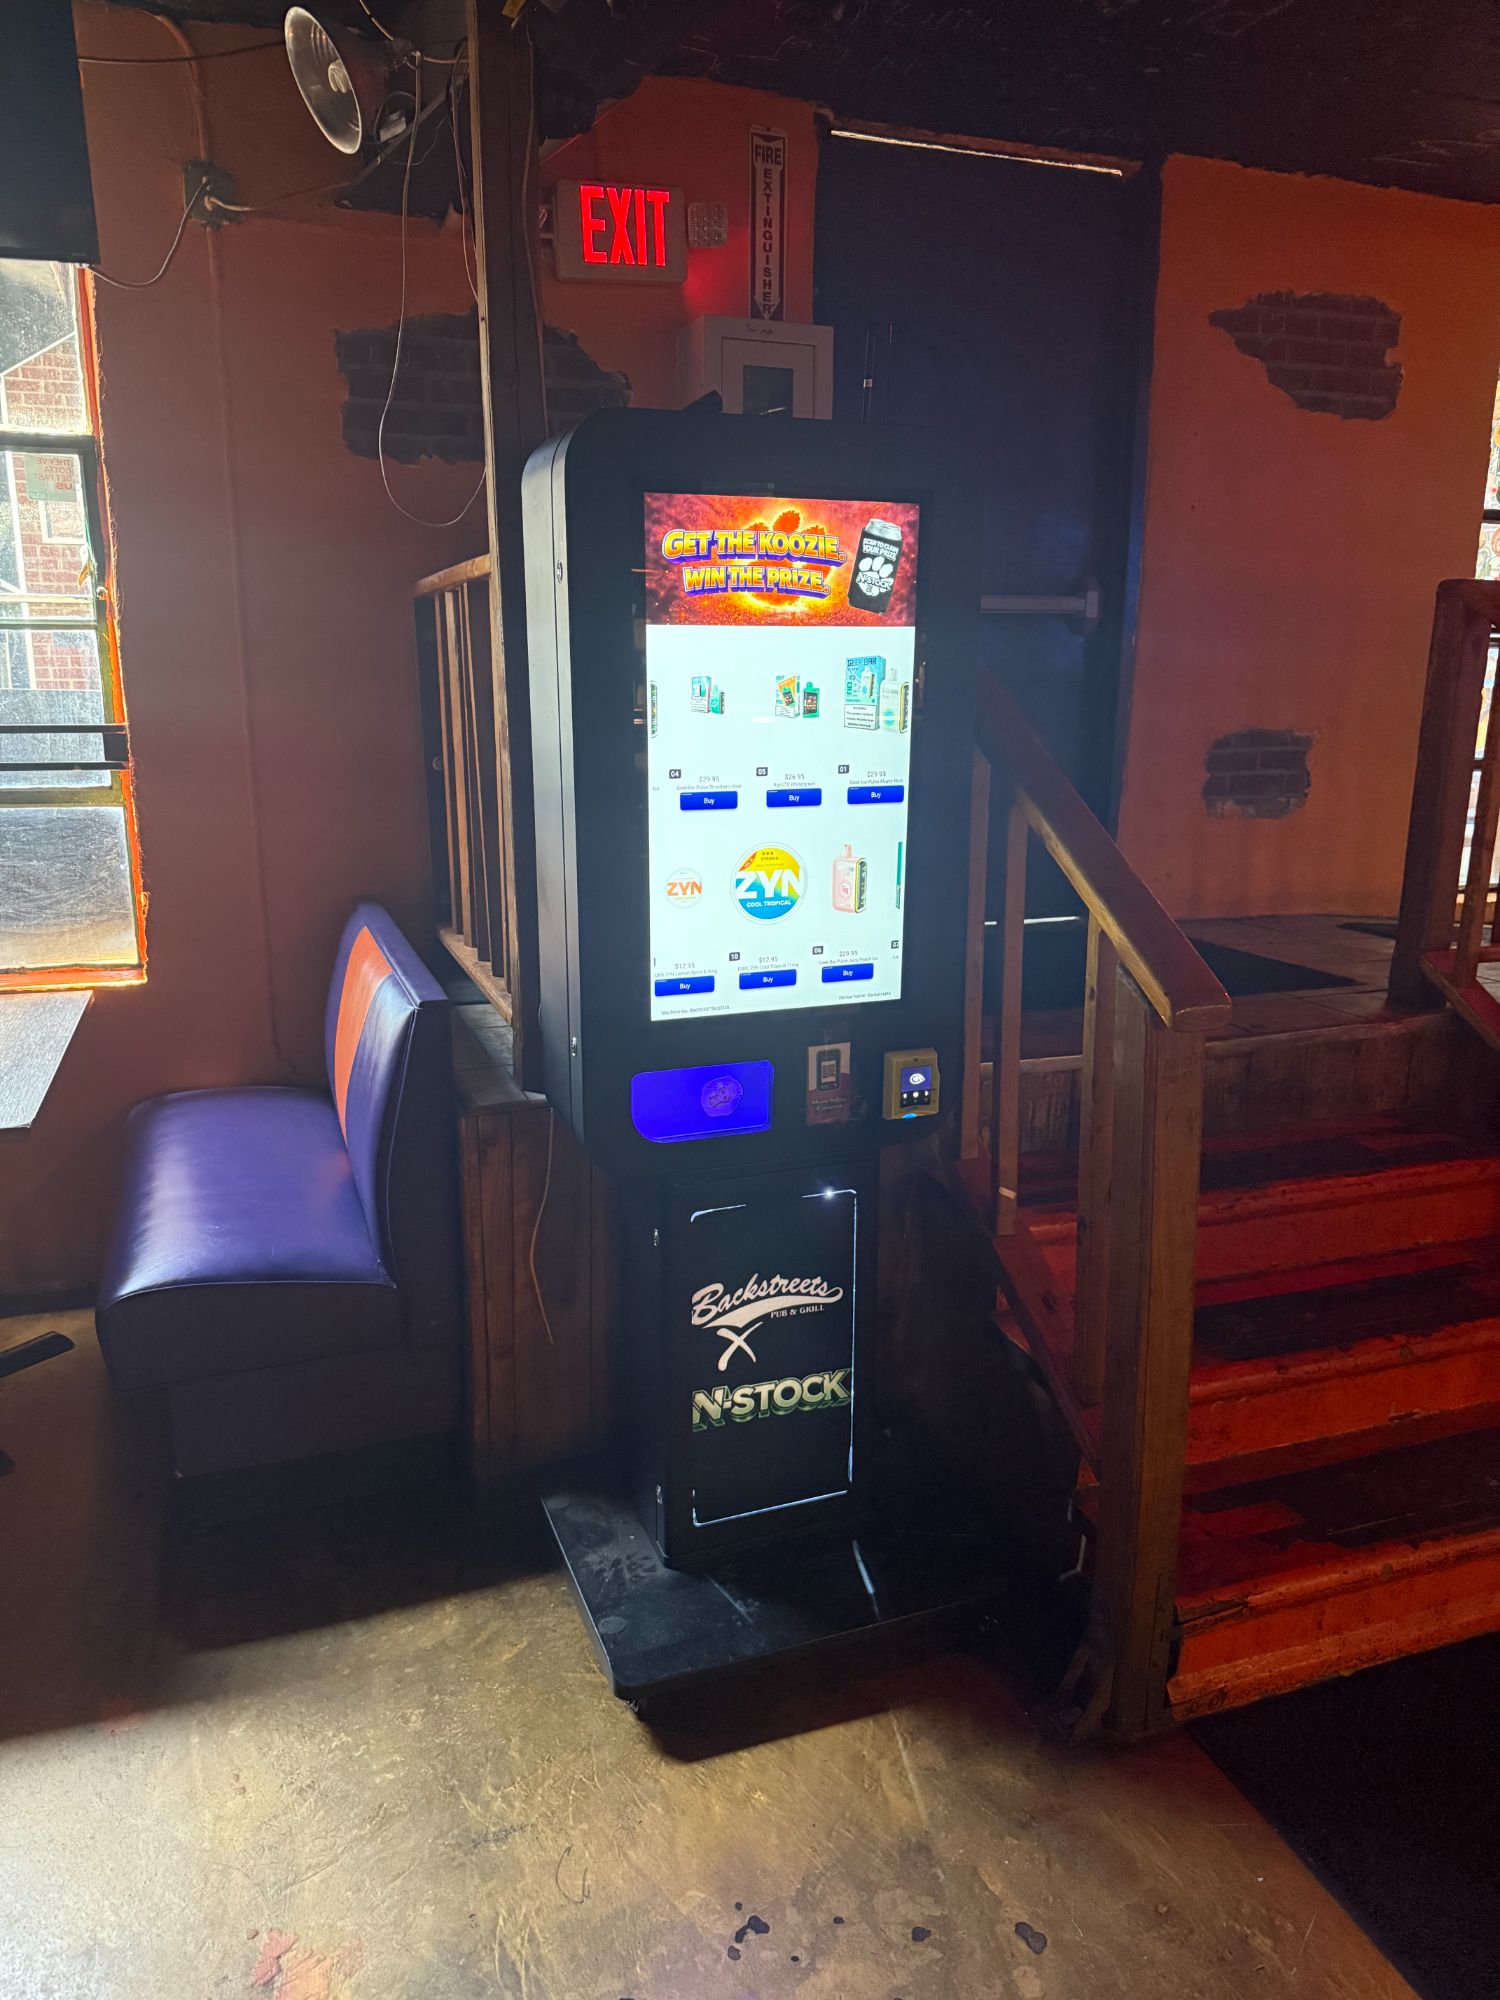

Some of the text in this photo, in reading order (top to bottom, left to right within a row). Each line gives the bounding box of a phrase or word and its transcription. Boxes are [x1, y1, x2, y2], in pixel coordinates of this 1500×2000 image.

[754, 145, 783, 166] FIRE
[580, 184, 670, 267] EXIT
[762, 167, 773, 315] EXTINGUISHER
[663, 529, 847, 565] GET THE KOOZIE.
[862, 544, 879, 555] YOUR
[884, 542, 899, 553] CLAIM
[683, 566, 831, 599] WIN THE PRIZE.
[858, 572, 892, 591] N-STOCK
[670, 769, 680, 778] 04
[839, 765, 847, 773] 01
[703, 797, 715, 805] Buy
[788, 794, 800, 802] Buy
[870, 791, 882, 799] Buy
[667, 880, 702, 897] ZYN
[736, 869, 801, 900] ZYN
[764, 899, 792, 907] TROPICAL
[762, 975, 774, 983] Buy
[842, 969, 853, 977] Buy
[679, 982, 691, 990] Buy
[692, 1273, 843, 1326] Backstreets
[770, 1304, 825, 1318] PUB & GRILL
[692, 1368, 852, 1432] N-STOCK
